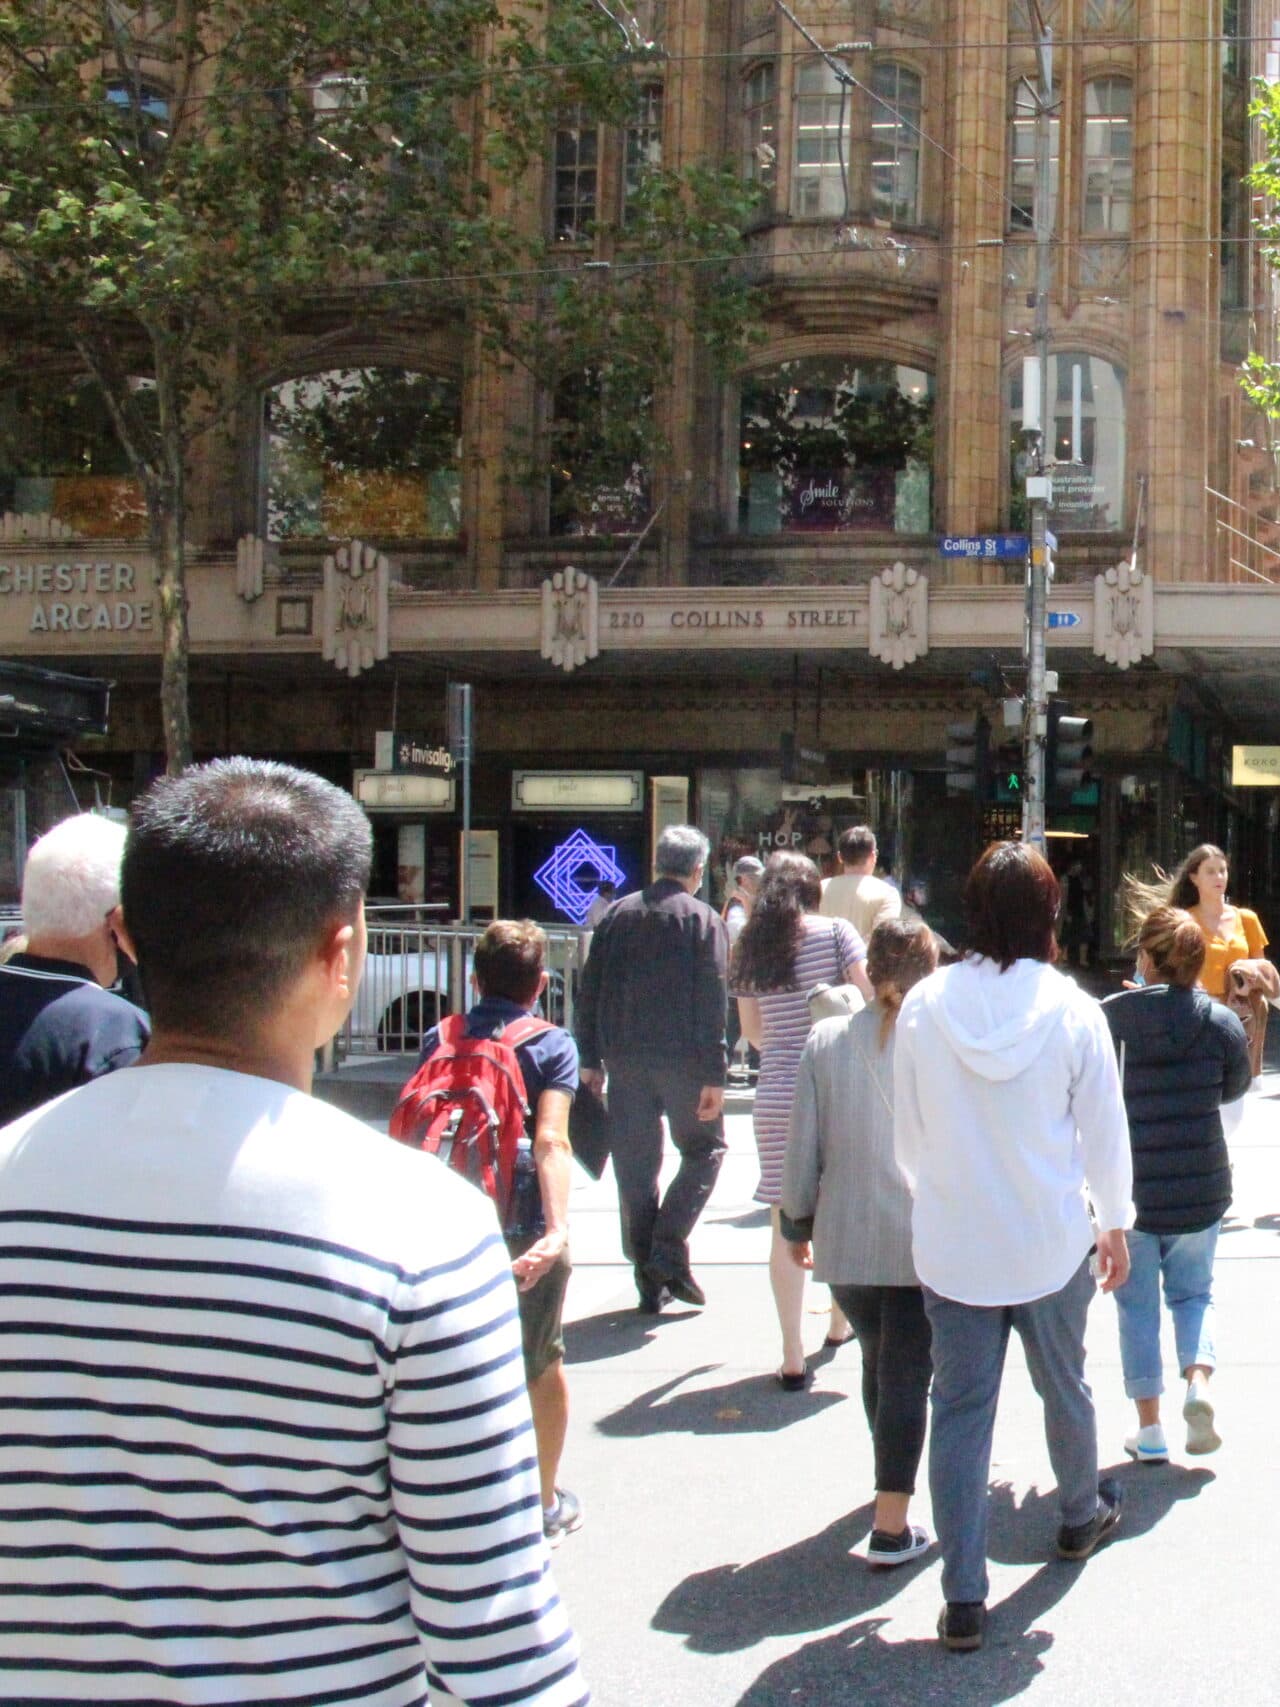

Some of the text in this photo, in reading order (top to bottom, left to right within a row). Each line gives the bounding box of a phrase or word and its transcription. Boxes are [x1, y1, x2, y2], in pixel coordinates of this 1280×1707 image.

[800, 478, 840, 512] Smile
[944, 539, 981, 551] Collins
[985, 539, 996, 551] St
[30, 602, 153, 632] ARCADE
[609, 609, 860, 628] 220 COLLINS STREET
[1244, 758, 1278, 767] KOKO
[759, 832, 802, 846] HOP
